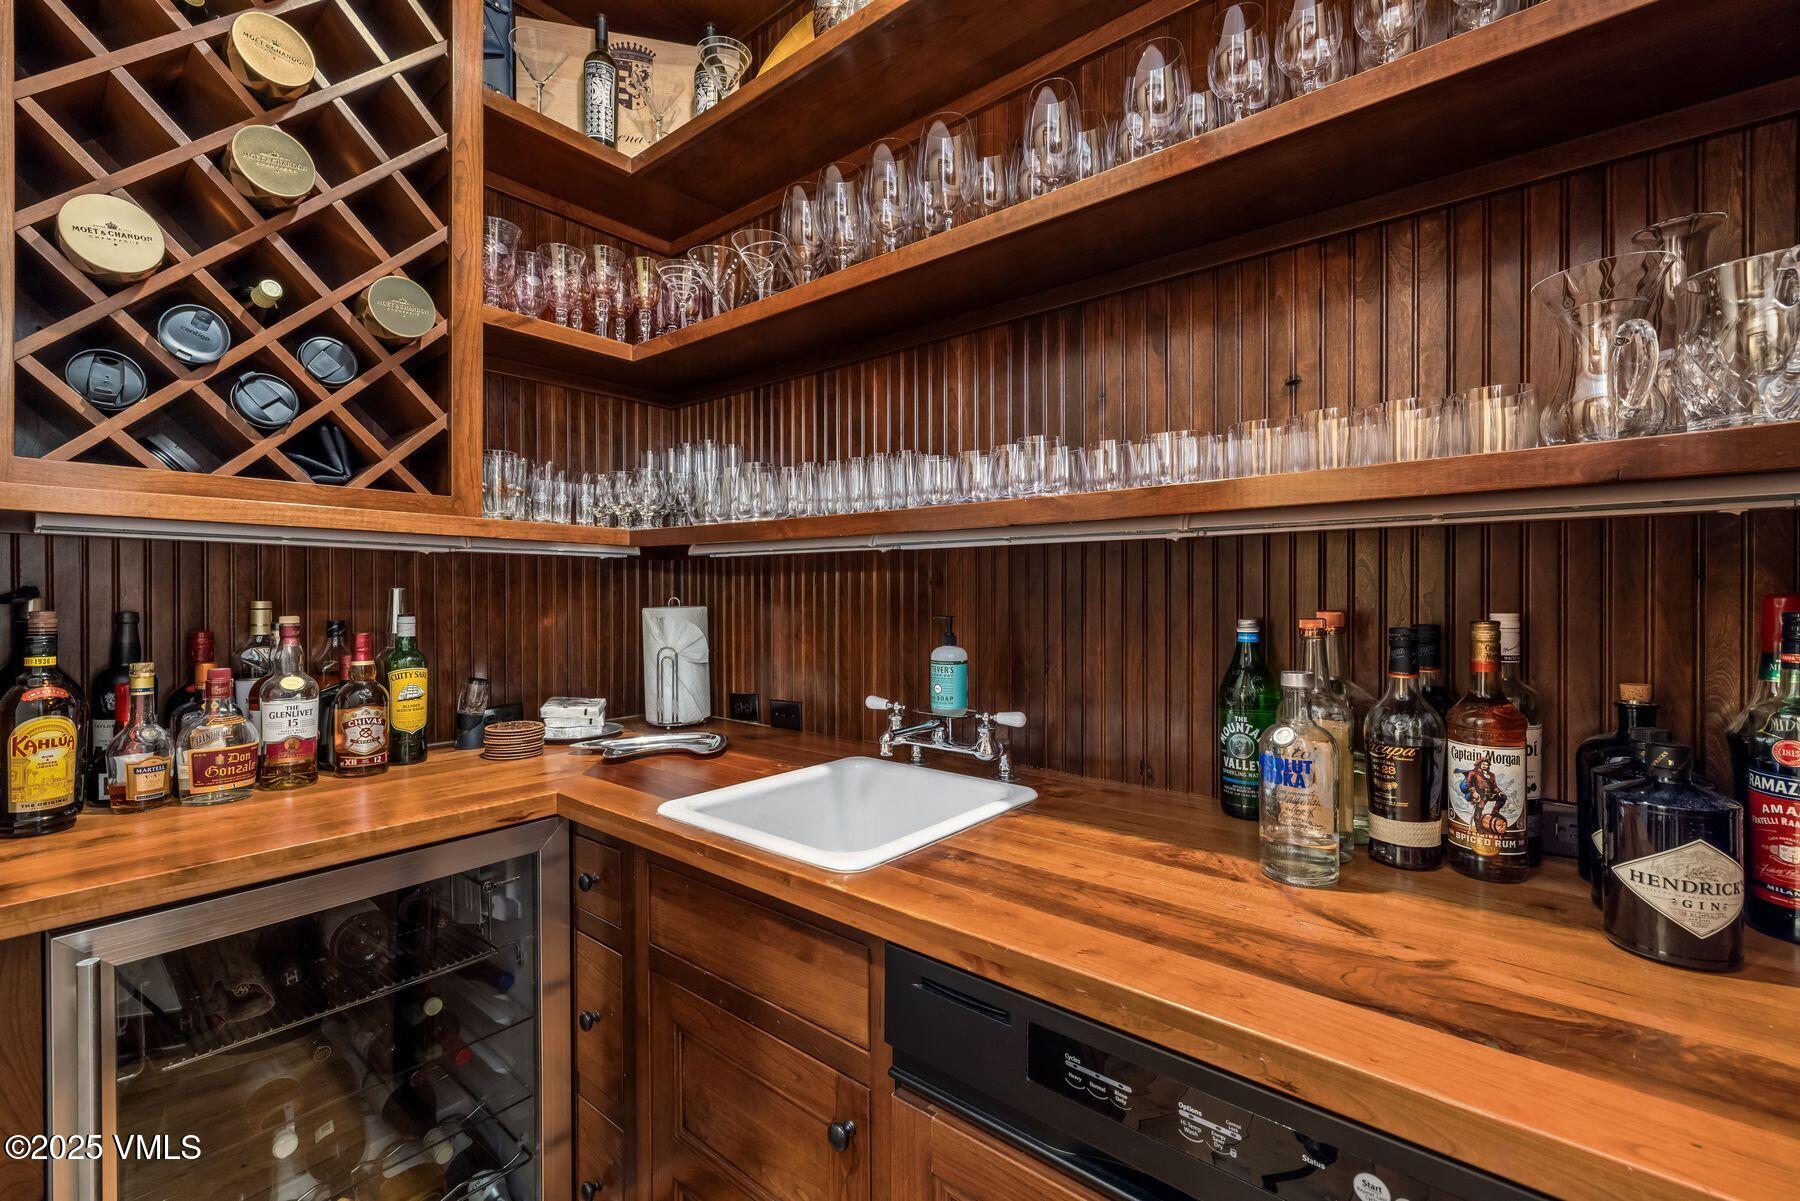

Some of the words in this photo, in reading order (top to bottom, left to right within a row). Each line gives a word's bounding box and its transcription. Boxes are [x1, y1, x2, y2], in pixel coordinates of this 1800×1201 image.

[617, 134, 644, 145] ena
[107, 230, 153, 242] CHANDON
[180, 325, 211, 342] contigo
[390, 671, 413, 682] CUTTY
[268, 708, 313, 720] GLENLIVET
[1234, 715, 1248, 723] THE
[287, 718, 299, 727] 15
[348, 718, 382, 727] CHIVAS
[11, 733, 75, 757] KAHLÚA
[227, 752, 251, 764] Don
[374, 756, 382, 764] 12
[1451, 745, 1482, 762] Captain
[1483, 749, 1521, 767] Morgan
[135, 764, 166, 774] MARTELL
[204, 761, 257, 778] Gonzalo
[37, 797, 68, 807] ORIGINAL
[1455, 831, 1491, 846] SPICED
[1494, 839, 1516, 848] RUM
[1681, 899, 1720, 911] GIN
[1064, 1052, 1081, 1064] Cycles
[1178, 1101, 1202, 1117] Options
[1183, 1126, 1199, 1137] Wash
[1213, 1141, 1224, 1151] Dry
[1302, 1154, 1326, 1170] Status
[1361, 1179, 1382, 1194] Start
